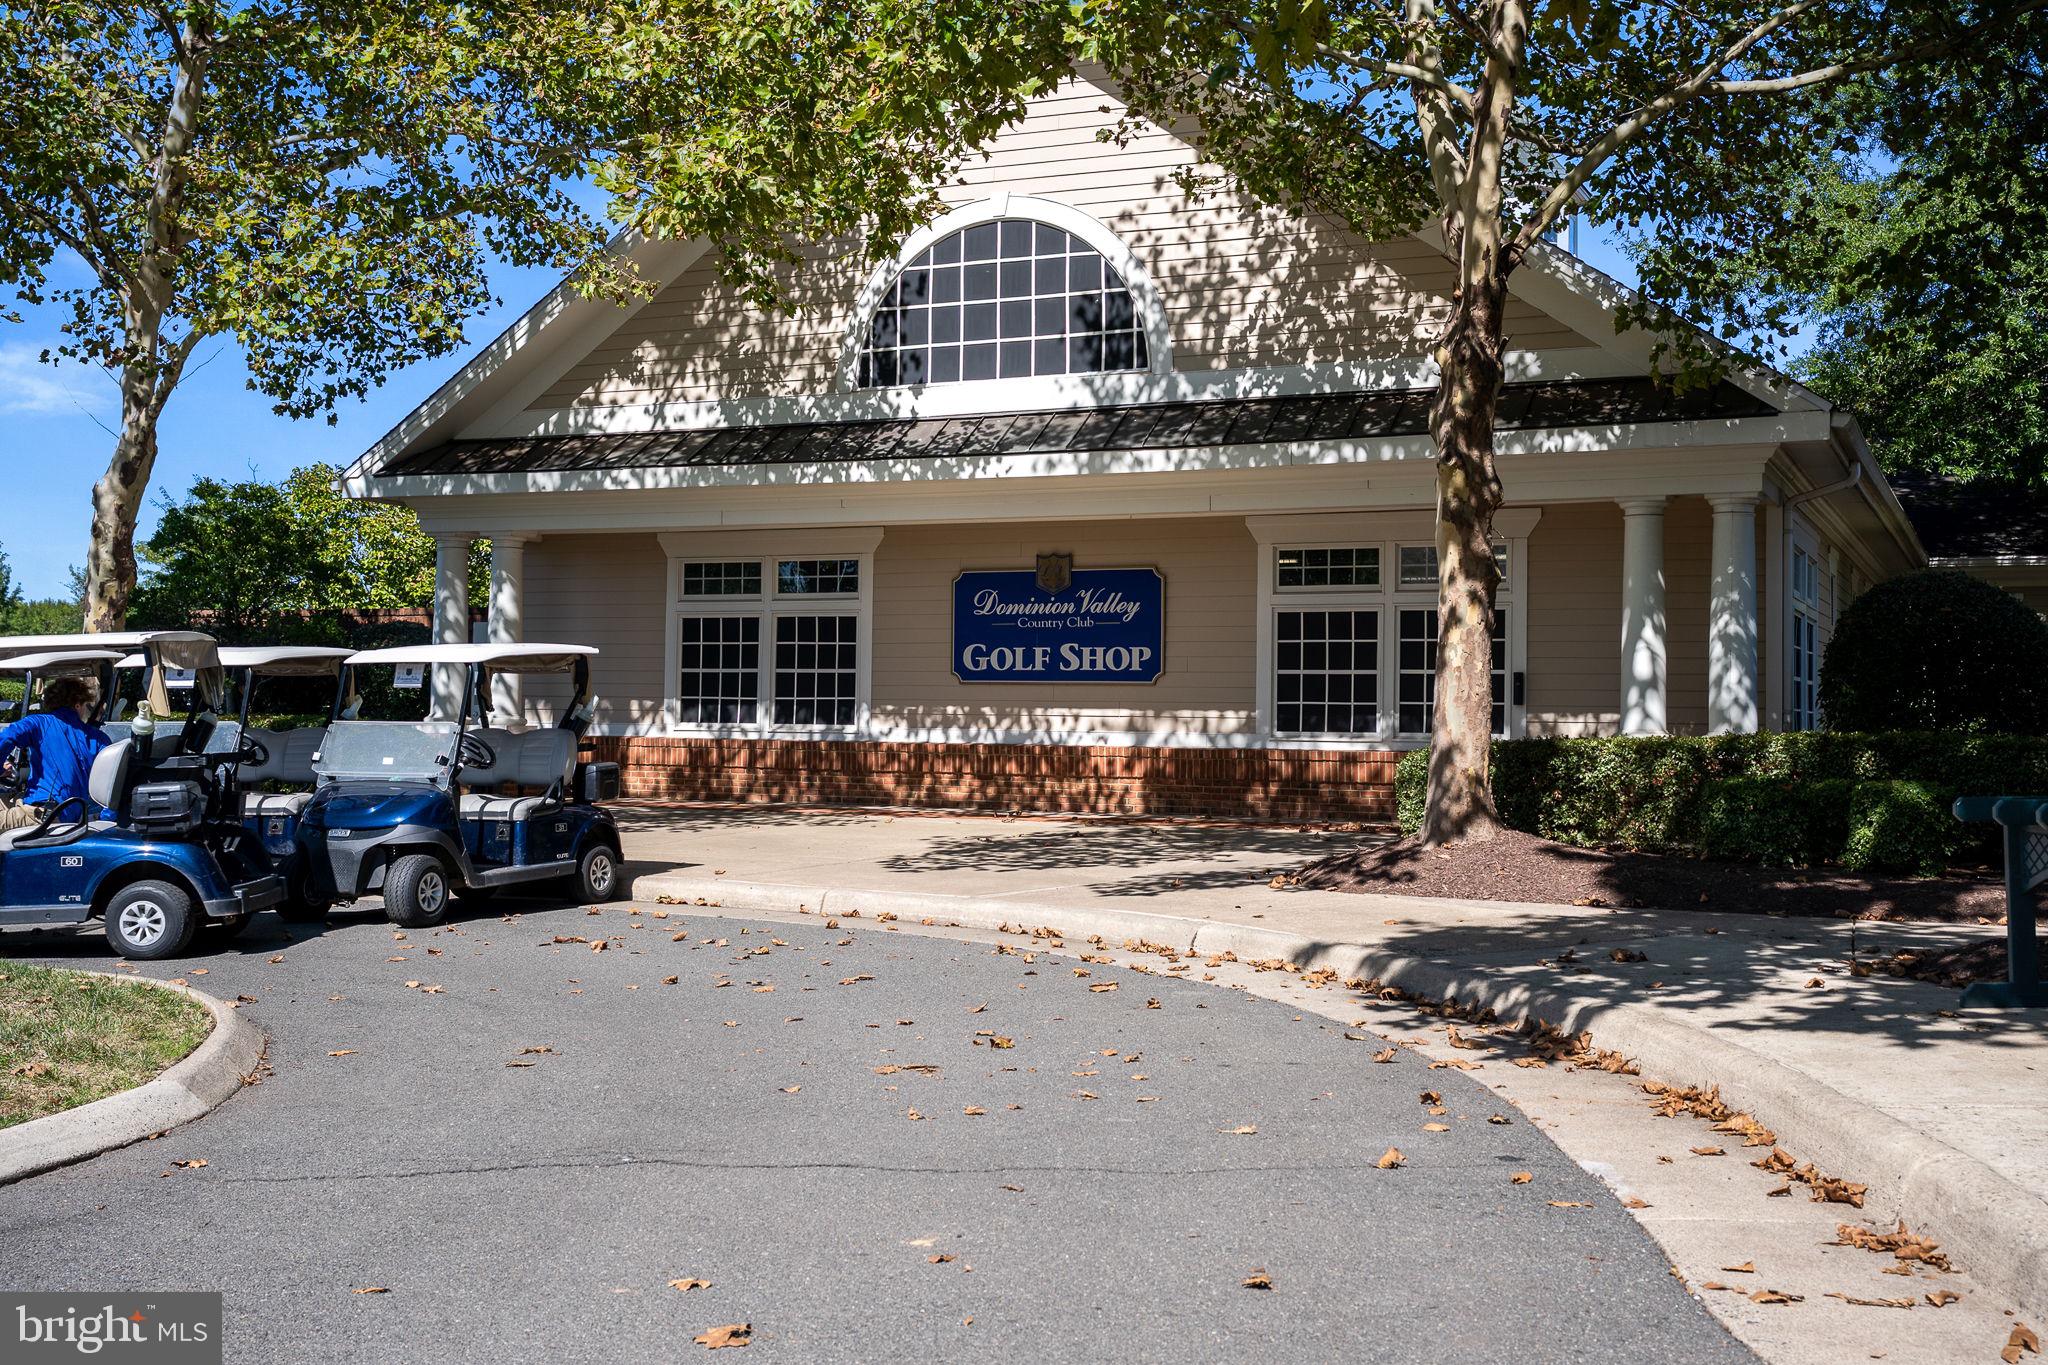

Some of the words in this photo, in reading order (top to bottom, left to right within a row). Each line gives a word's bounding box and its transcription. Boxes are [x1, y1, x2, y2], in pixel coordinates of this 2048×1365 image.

[973, 589, 1076, 615] Dominion
[1076, 587, 1140, 622] Valley
[1017, 617, 1064, 629] Country
[1066, 616, 1094, 628] Club
[962, 643, 1051, 671] GOLF
[1059, 643, 1152, 671] SHOP
